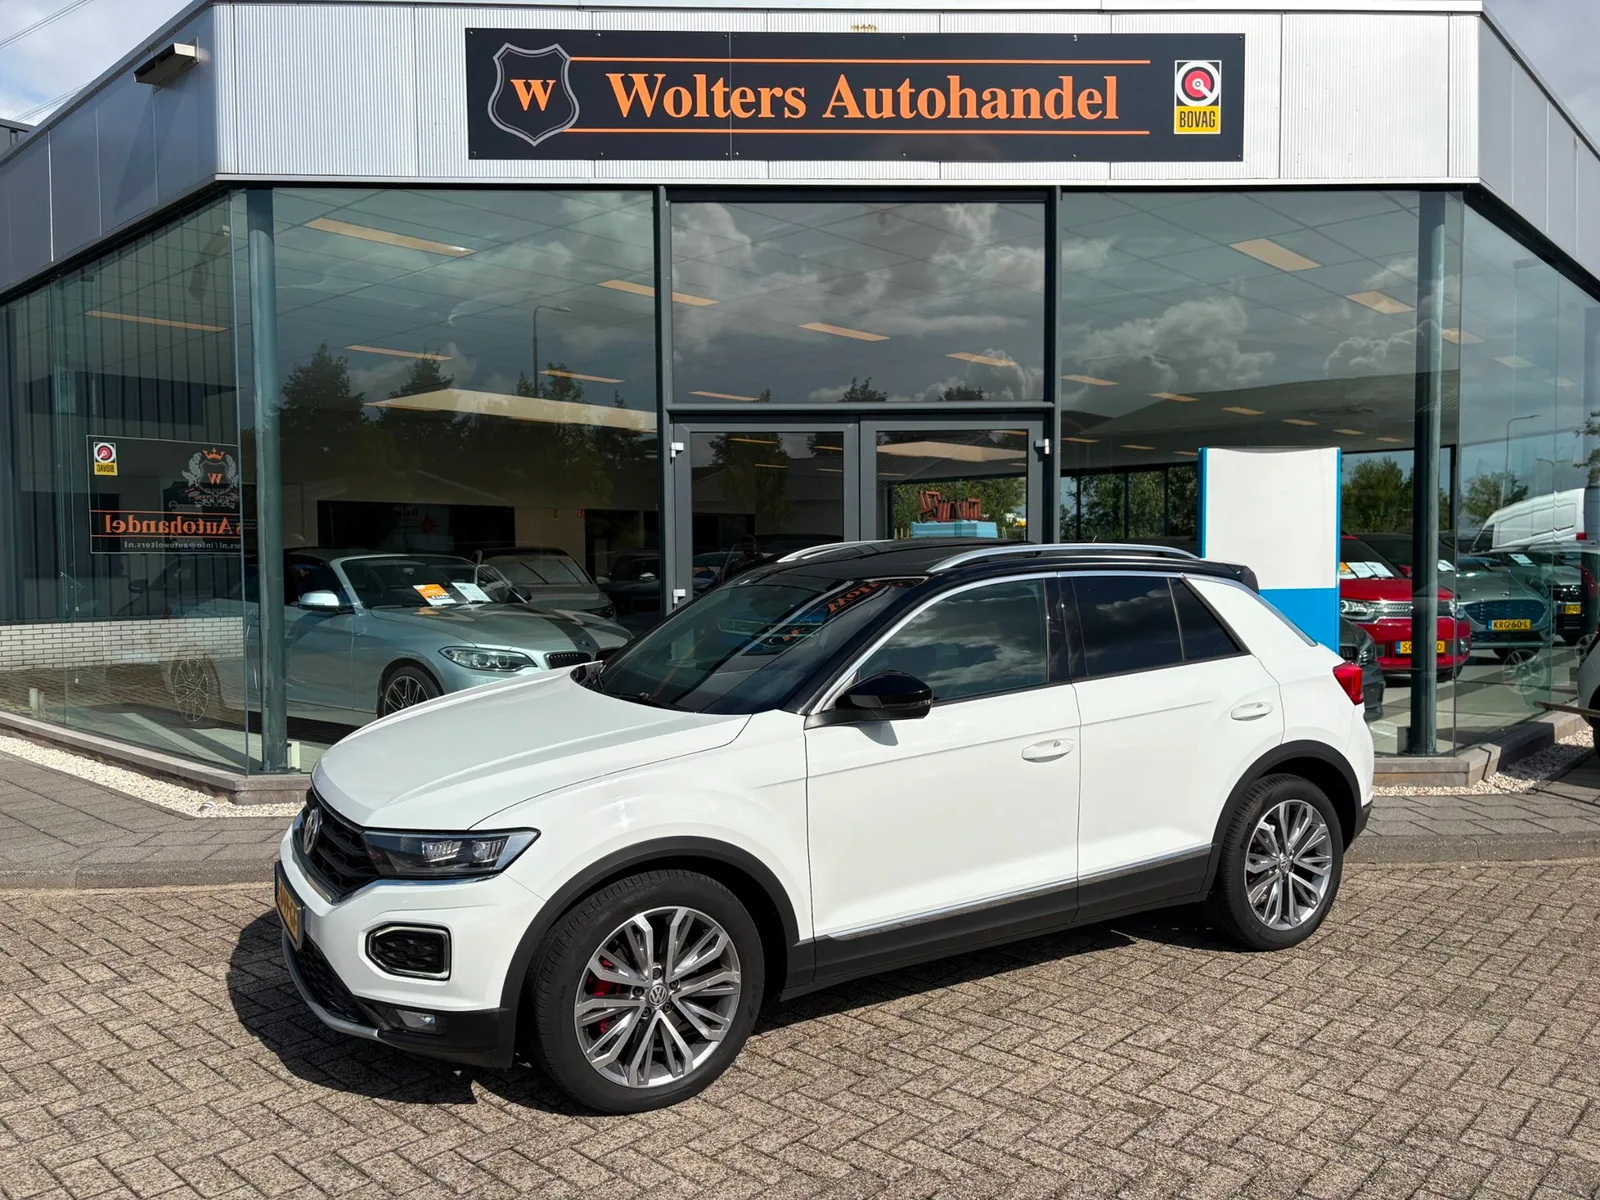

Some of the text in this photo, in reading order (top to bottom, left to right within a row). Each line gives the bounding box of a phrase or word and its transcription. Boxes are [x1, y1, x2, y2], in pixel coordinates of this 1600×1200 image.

[510, 79, 556, 112] W
[605, 72, 1120, 121] Wolters Autohandel
[1179, 110, 1216, 128] BOVAG
